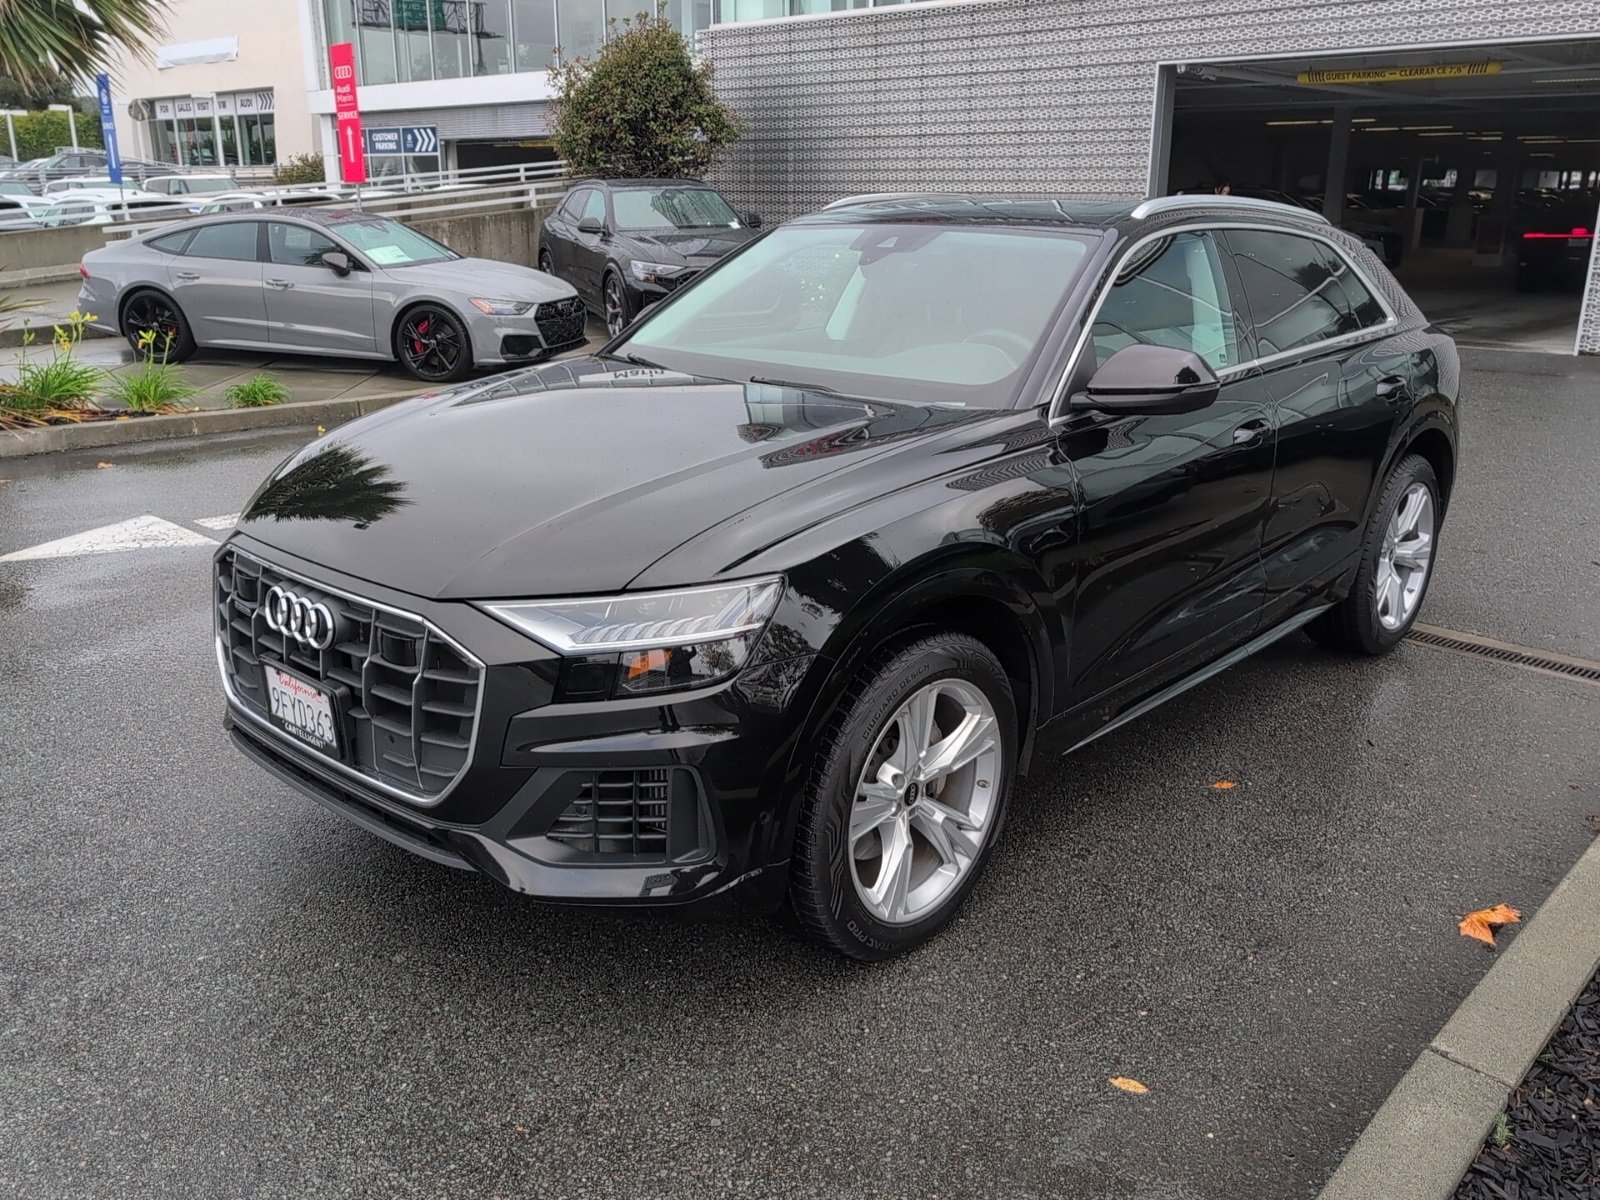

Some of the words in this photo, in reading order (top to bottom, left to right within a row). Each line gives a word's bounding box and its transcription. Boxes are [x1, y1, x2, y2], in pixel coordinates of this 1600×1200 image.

[1325, 71, 1351, 81] GUEST
[1351, 70, 1386, 79] PARKING
[336, 84, 351, 93] Audi
[337, 93, 354, 102] Marin
[159, 104, 169, 113] FOR
[177, 103, 192, 112] SALES
[196, 102, 209, 111] VISIT
[240, 98, 253, 108] AUDI
[337, 110, 359, 120] SERVICE
[372, 132, 398, 141] CUSTOMER
[375, 142, 397, 150] PARKING
[899, 663, 930, 690] DESIGN
[279, 671, 319, 699] California
[272, 686, 335, 743] 9FYD363
